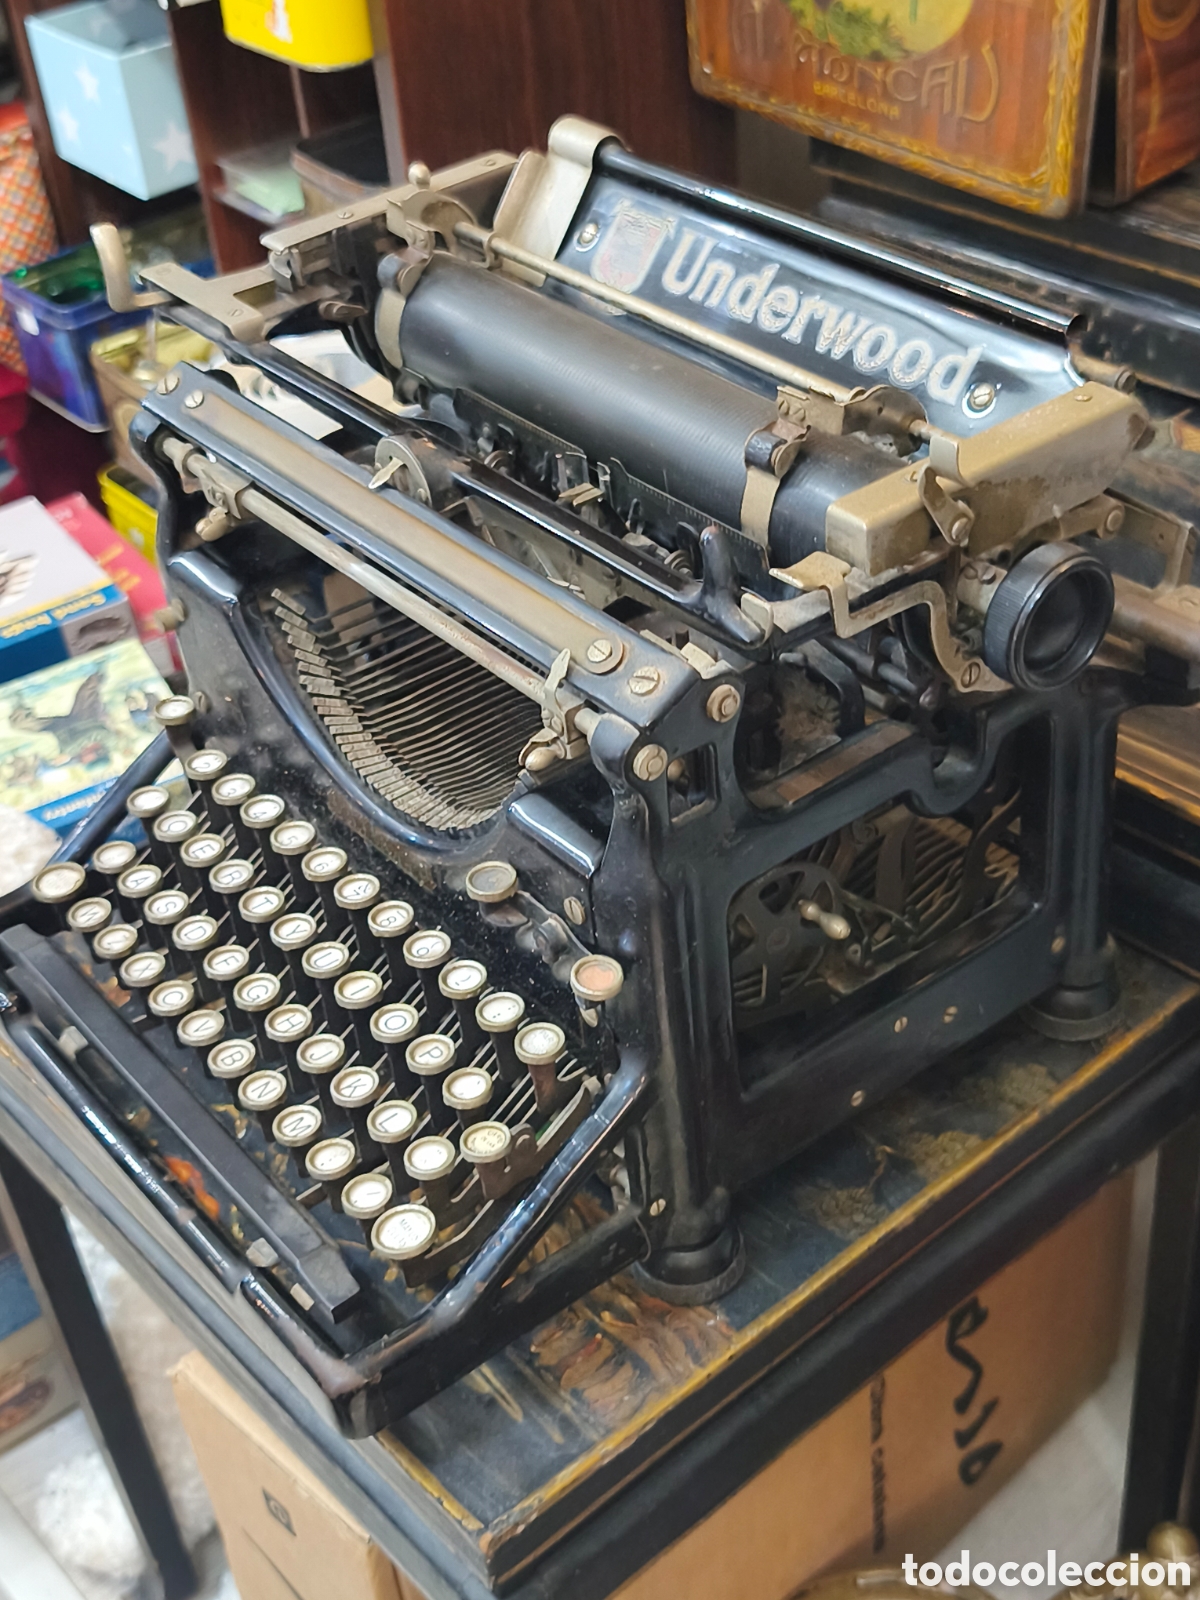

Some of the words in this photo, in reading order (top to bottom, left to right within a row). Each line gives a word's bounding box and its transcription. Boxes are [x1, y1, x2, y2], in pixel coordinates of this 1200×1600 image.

[661, 227, 986, 406] Underwood
[191, 843, 216, 859] E
[130, 875, 151, 889] A
[221, 869, 243, 883] R
[156, 900, 177, 915] S
[251, 896, 274, 910] T
[183, 925, 207, 941] D
[285, 924, 307, 938] Y
[214, 954, 240, 967] F
[313, 951, 340, 969] U
[162, 990, 184, 1006] C
[246, 983, 269, 1002] G
[276, 1013, 303, 1031] H
[384, 1014, 407, 1031] O
[220, 1050, 244, 1067] B
[308, 1050, 334, 1062] J
[418, 1045, 444, 1061] P
[250, 1080, 278, 1099] N
[340, 1077, 367, 1098] K
[283, 1116, 312, 1137] M
[378, 1112, 399, 1133] L
